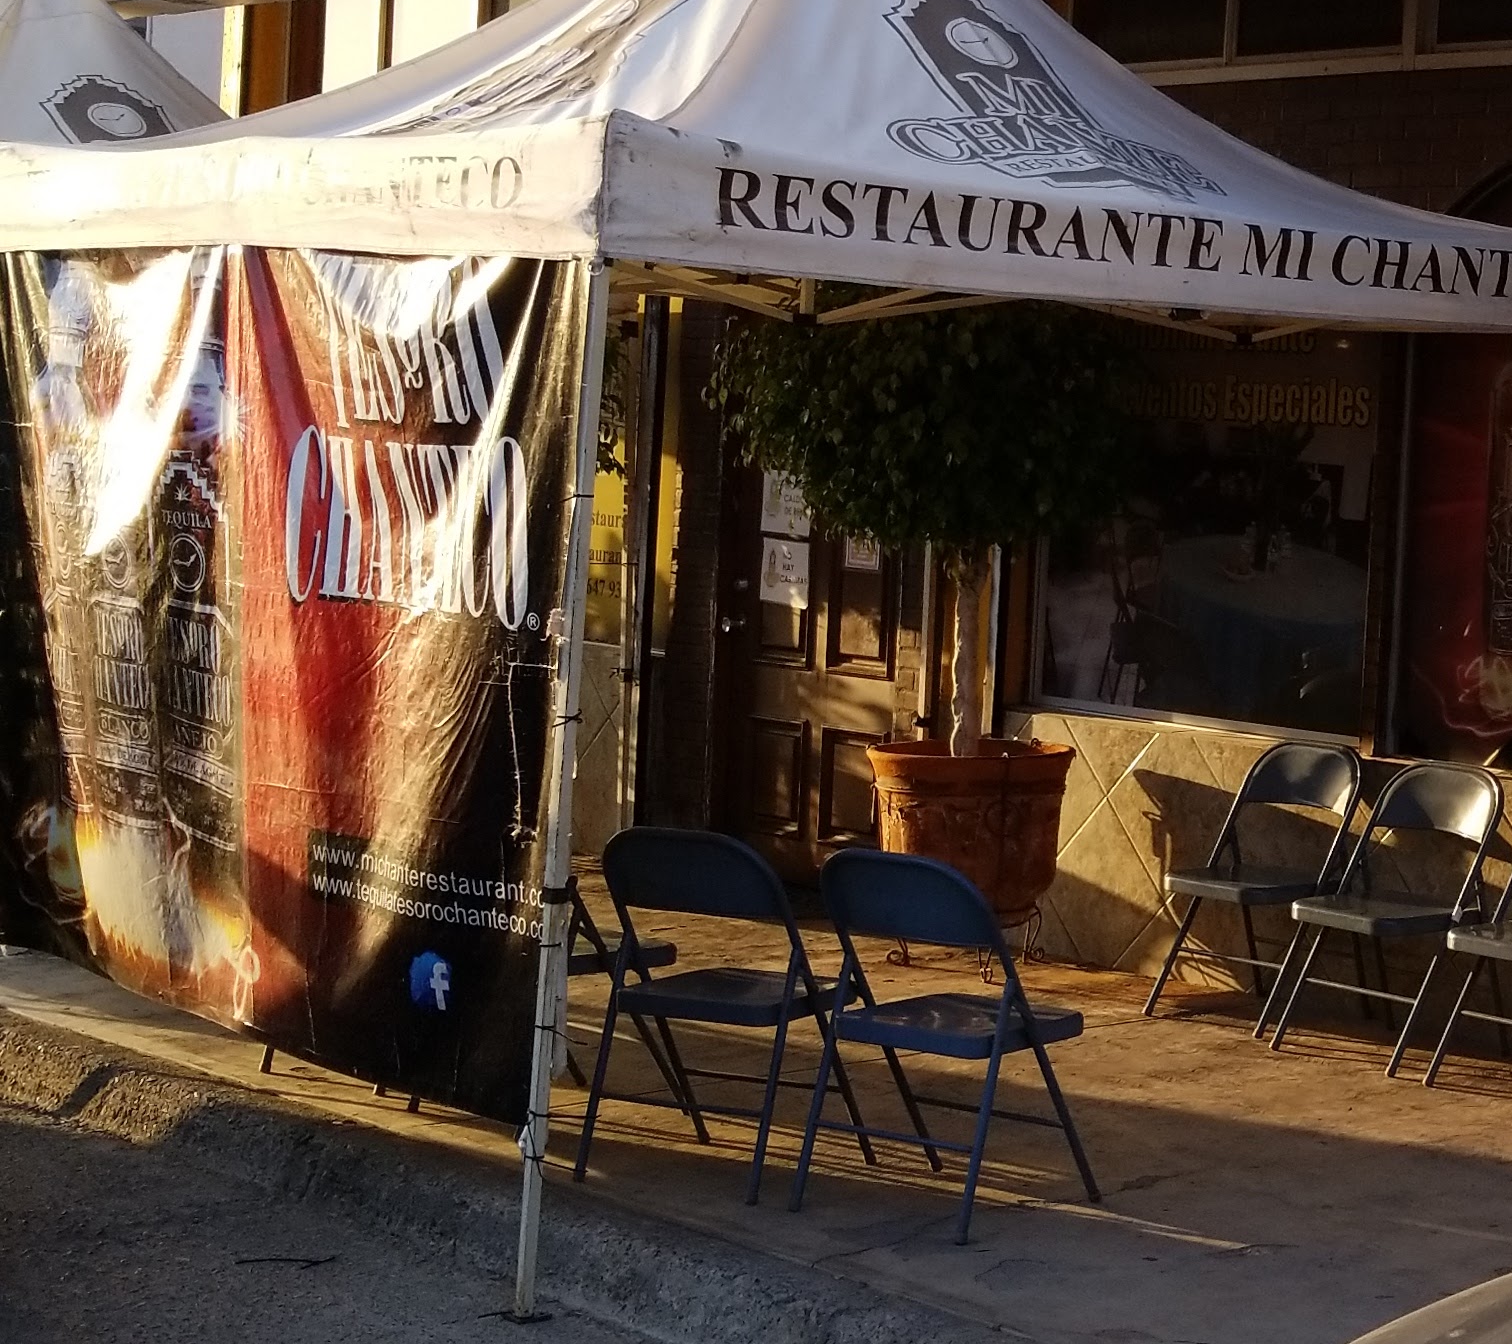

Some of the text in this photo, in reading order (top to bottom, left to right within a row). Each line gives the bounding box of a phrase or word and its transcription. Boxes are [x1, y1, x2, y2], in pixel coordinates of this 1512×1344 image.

[955, 70, 1082, 121] MI
[715, 166, 1225, 273] RESTAURANTE
[1238, 222, 1318, 282] MI
[1224, 374, 1372, 428] Especiales
